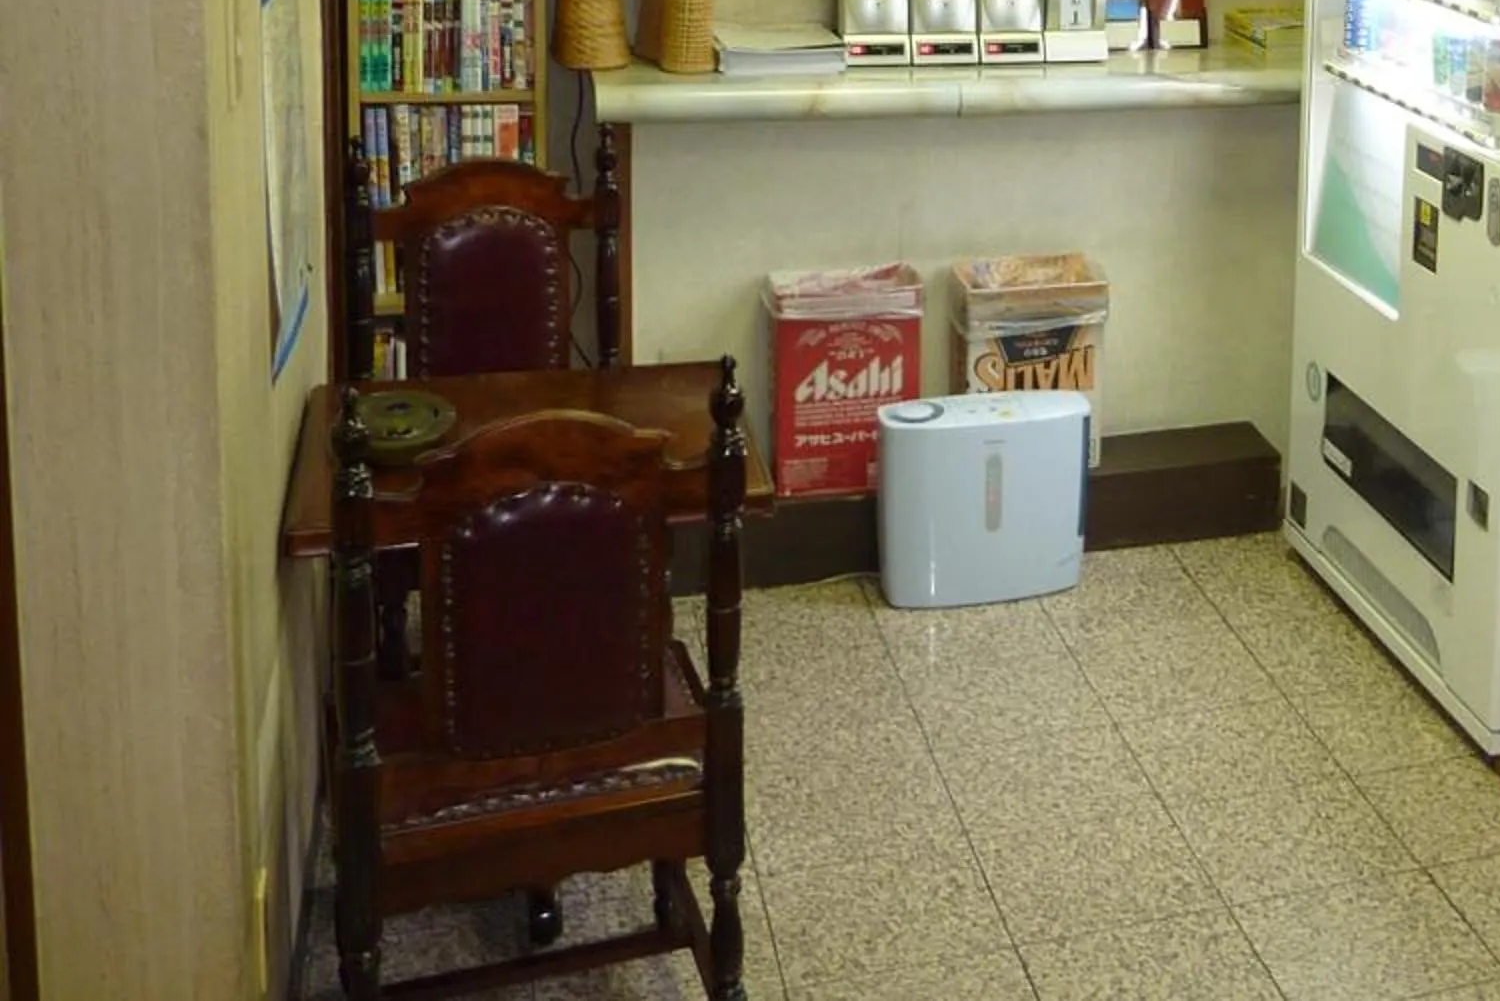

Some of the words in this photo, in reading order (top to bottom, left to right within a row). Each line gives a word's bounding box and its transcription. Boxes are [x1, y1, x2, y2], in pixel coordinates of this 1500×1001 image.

[794, 354, 903, 402] Asahi
[794, 430, 878, 447] アサヒスーパー
